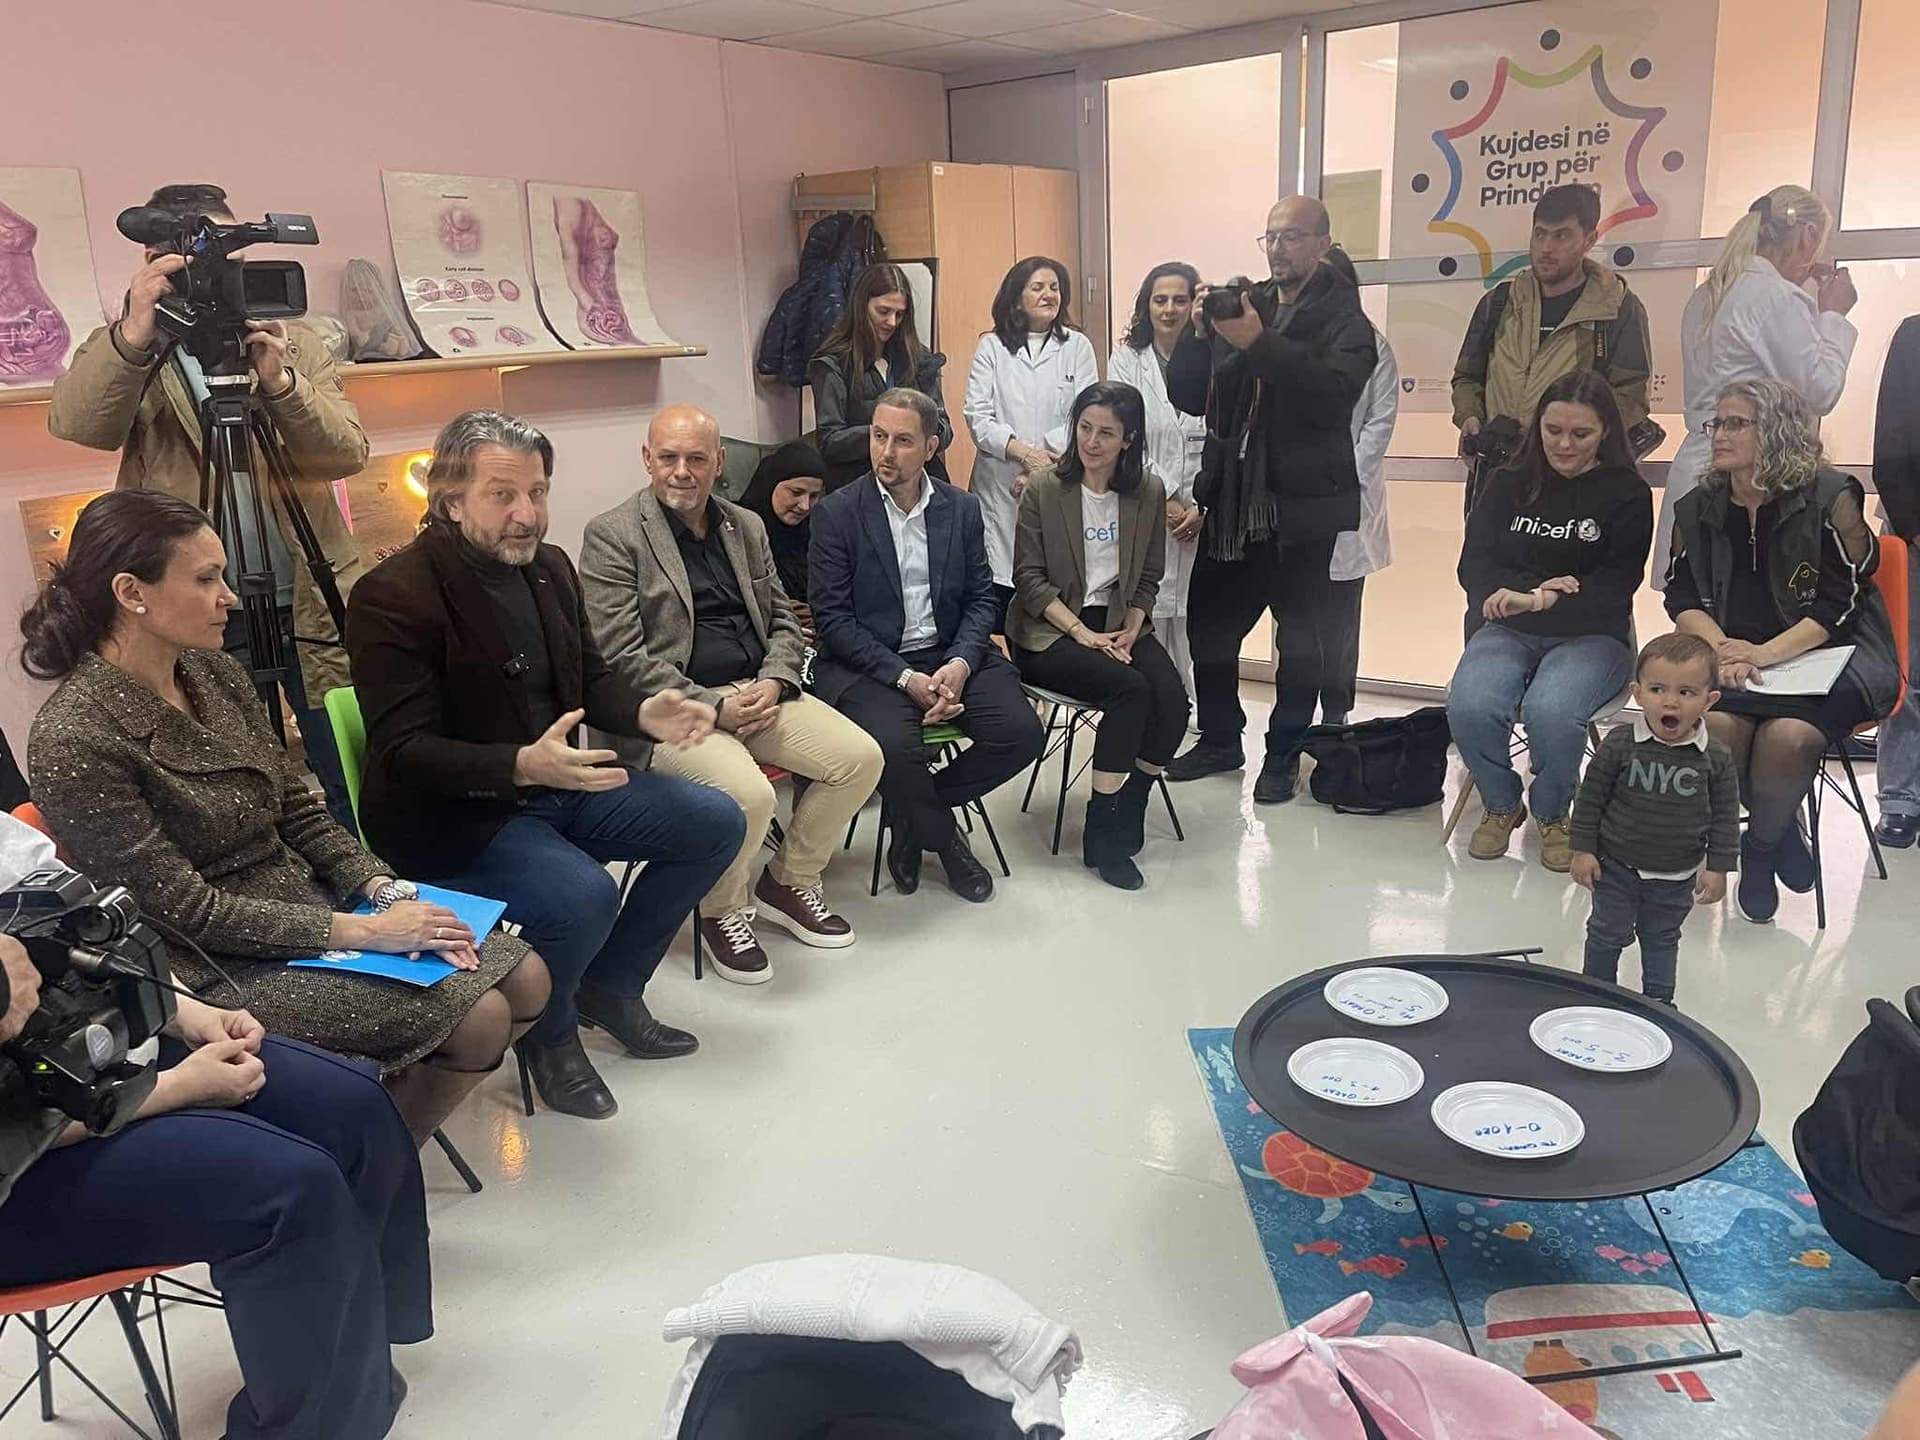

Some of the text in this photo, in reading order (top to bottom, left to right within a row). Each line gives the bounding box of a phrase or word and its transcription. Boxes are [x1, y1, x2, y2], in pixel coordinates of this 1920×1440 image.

[1479, 122, 1610, 159] Kujdesi në
[1486, 150, 1600, 185] Grup për
[1510, 515, 1576, 539] unicef
[1627, 758, 1699, 796] NYC
